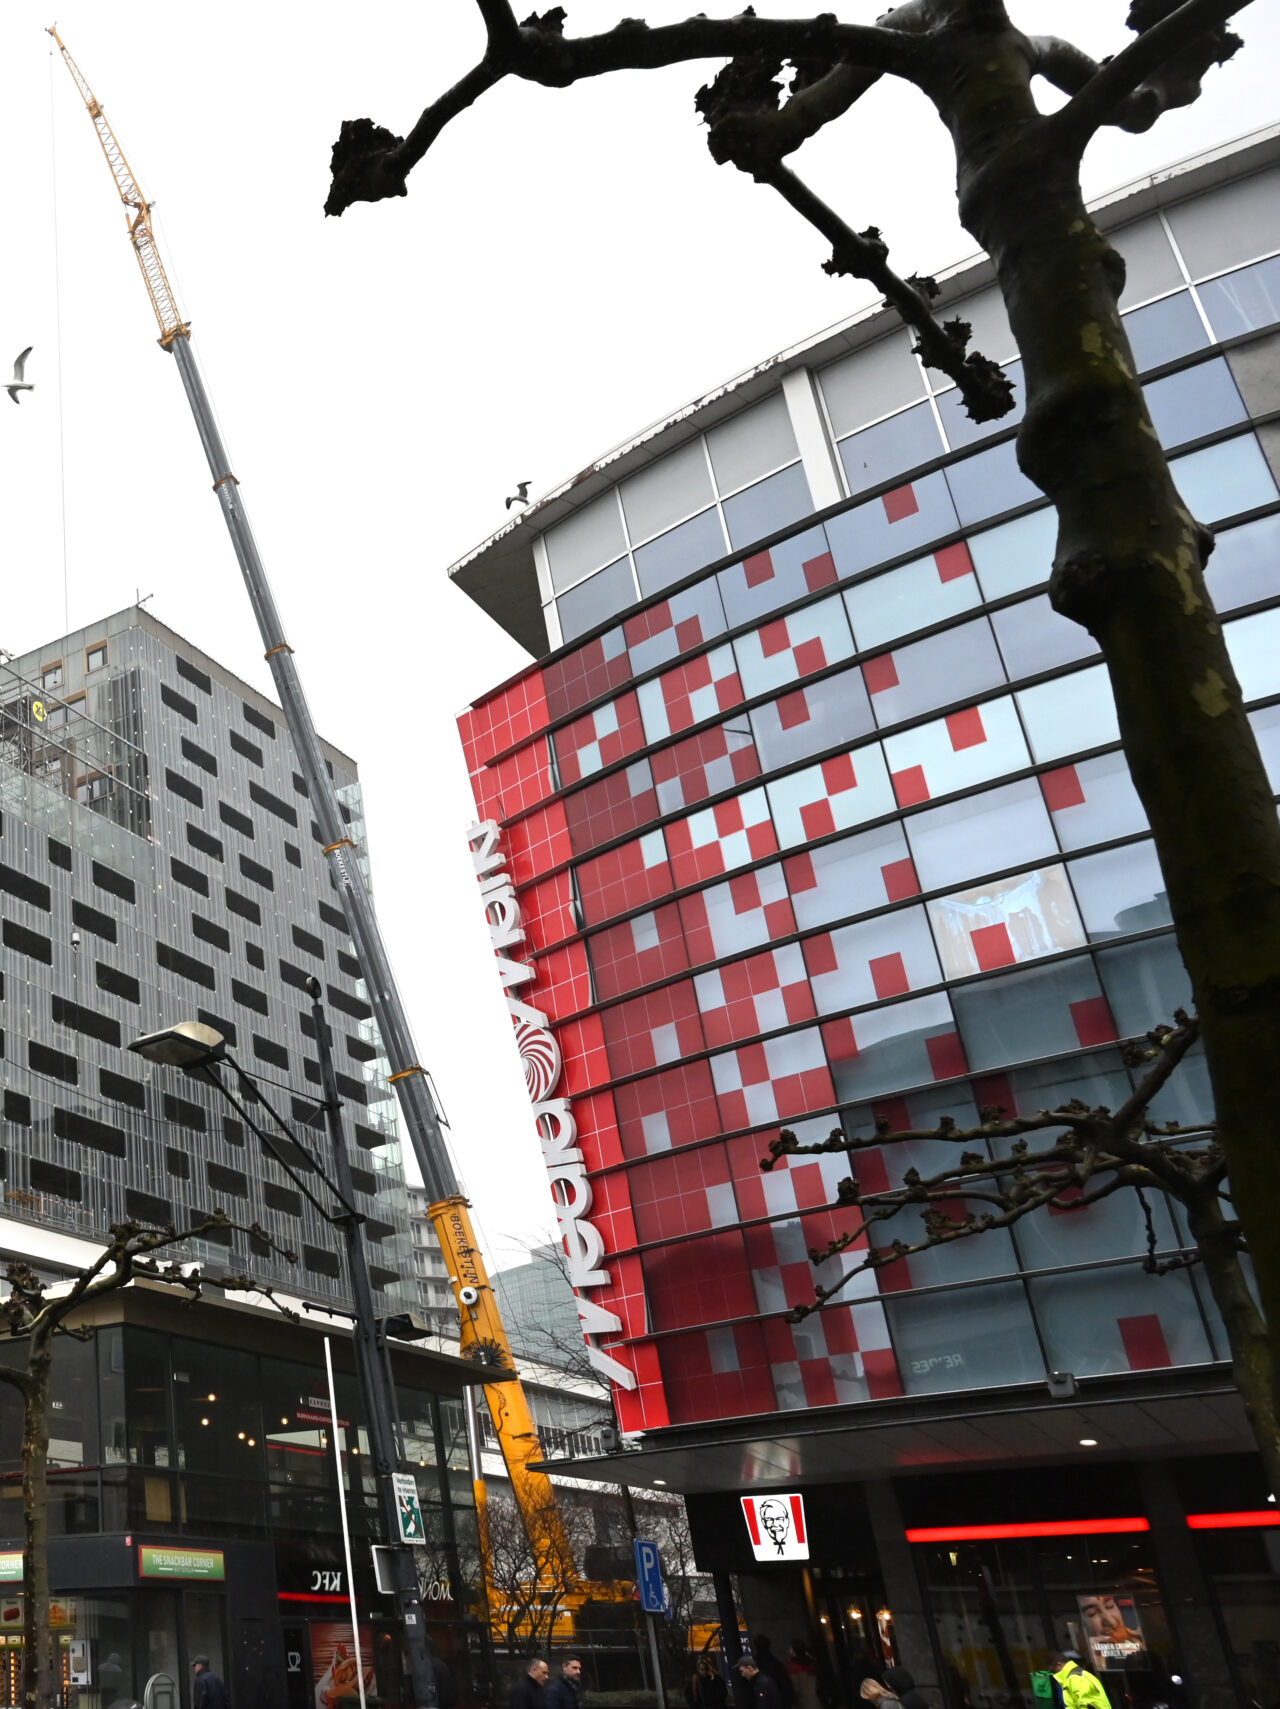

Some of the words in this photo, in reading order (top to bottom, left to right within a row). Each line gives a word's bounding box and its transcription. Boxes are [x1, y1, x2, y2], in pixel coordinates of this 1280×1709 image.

[450, 1214, 479, 1284] BOEKESTIJN
[152, 1554, 163, 1566] THE
[163, 1555, 192, 1567] SNACKBAR
[193, 1558, 214, 1569] CORNER
[642, 1546, 654, 1582] P
